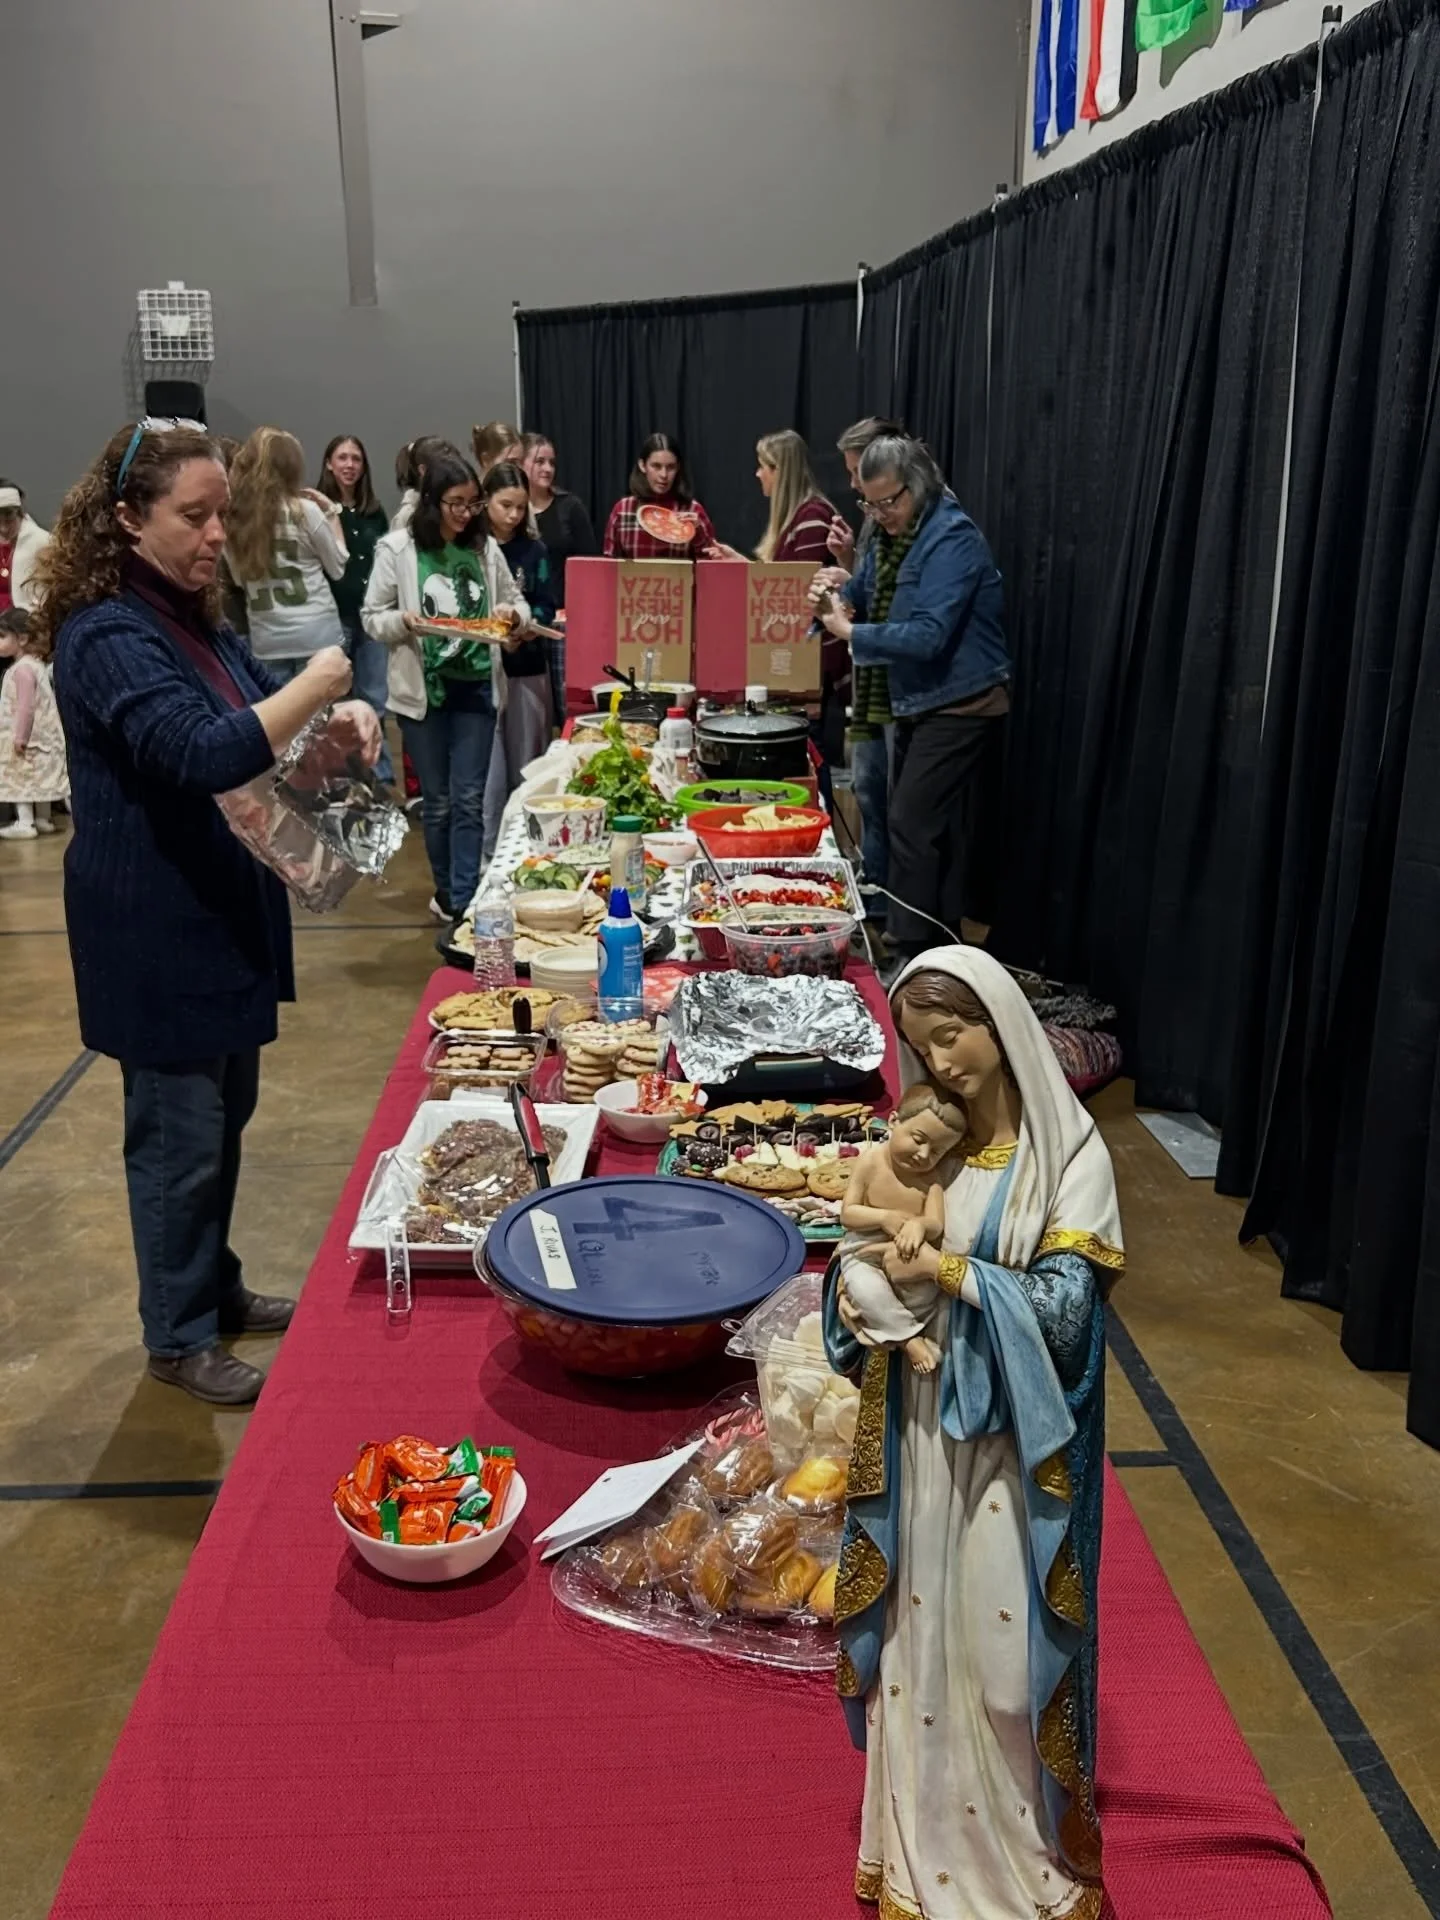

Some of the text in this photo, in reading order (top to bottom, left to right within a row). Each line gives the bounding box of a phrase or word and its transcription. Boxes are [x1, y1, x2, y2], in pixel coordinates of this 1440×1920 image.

[250, 539, 308, 611] 5
[621, 576, 685, 597] PIZZA
[620, 597, 685, 617] FRESH
[620, 616, 684, 645] HOT
[631, 612, 671, 631] and
[762, 612, 801, 632] and
[572, 1197, 726, 1241] 4
